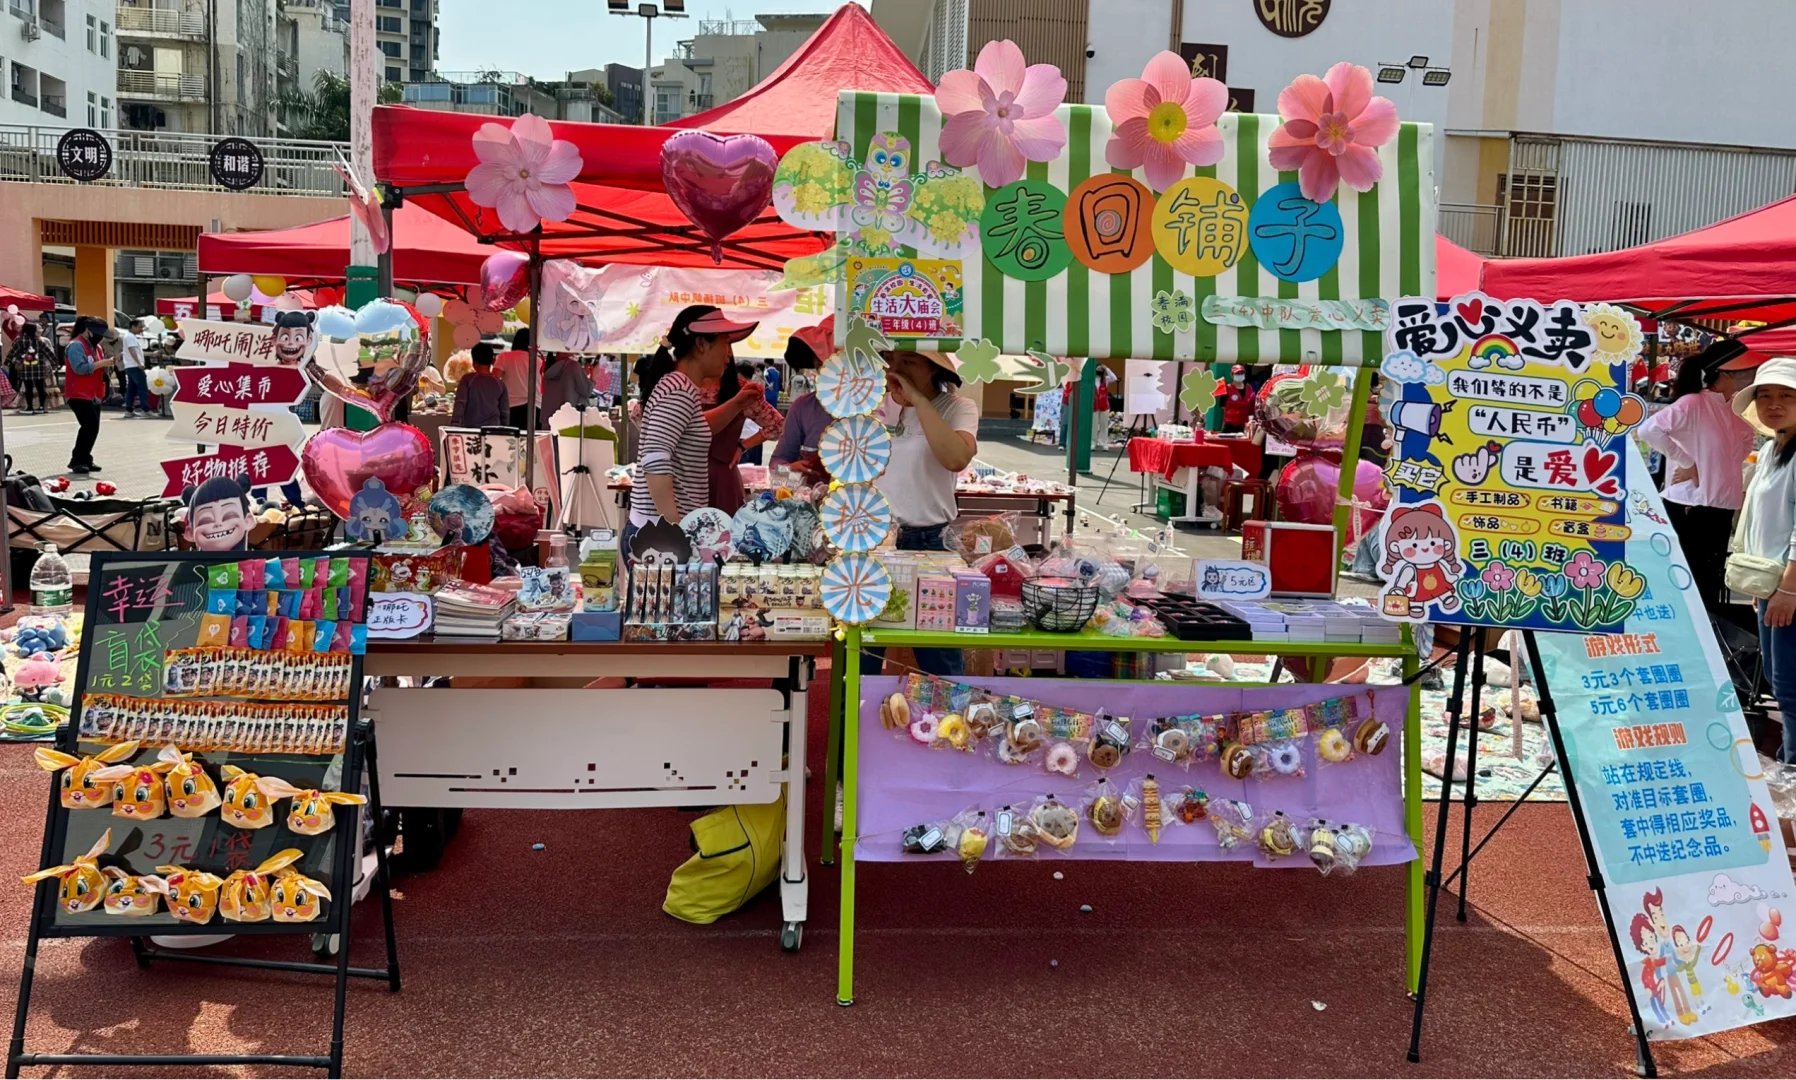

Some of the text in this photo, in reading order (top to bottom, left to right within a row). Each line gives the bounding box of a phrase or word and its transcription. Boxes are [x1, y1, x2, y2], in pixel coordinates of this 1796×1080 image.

[71, 146, 98, 165] 文明
[223, 155, 250, 173] 和谐
[987, 182, 1336, 276] 春回铺子
[873, 293, 941, 315] 生活大庙会
[194, 329, 275, 359] 哪吒闹海
[1395, 304, 1591, 368] 爱心义卖
[198, 373, 271, 400] 爱心集市
[1452, 377, 1564, 402] 我们等的不是
[194, 411, 274, 441] 今日特价
[182, 451, 271, 486] 好物推荐
[1393, 461, 1442, 488] 买它
[1514, 450, 1577, 486] 是爱
[1466, 491, 1520, 505] 手工制品
[1551, 497, 1577, 511] 书籍
[1473, 516, 1500, 529] 饰品
[1563, 521, 1590, 535] 盲盒
[1230, 576, 1256, 587] 5元区
[102, 575, 185, 623] 幸运
[371, 614, 408, 624] 正版卡
[95, 619, 162, 675] 盲袋
[1585, 633, 1661, 658] 游戏形式
[1582, 663, 1684, 690] 3元3个套圈圈
[1591, 688, 1690, 716] 5元6个套圈圈
[1613, 722, 1687, 750] 游戏规则
[144, 832, 254, 871] 3元1袋
